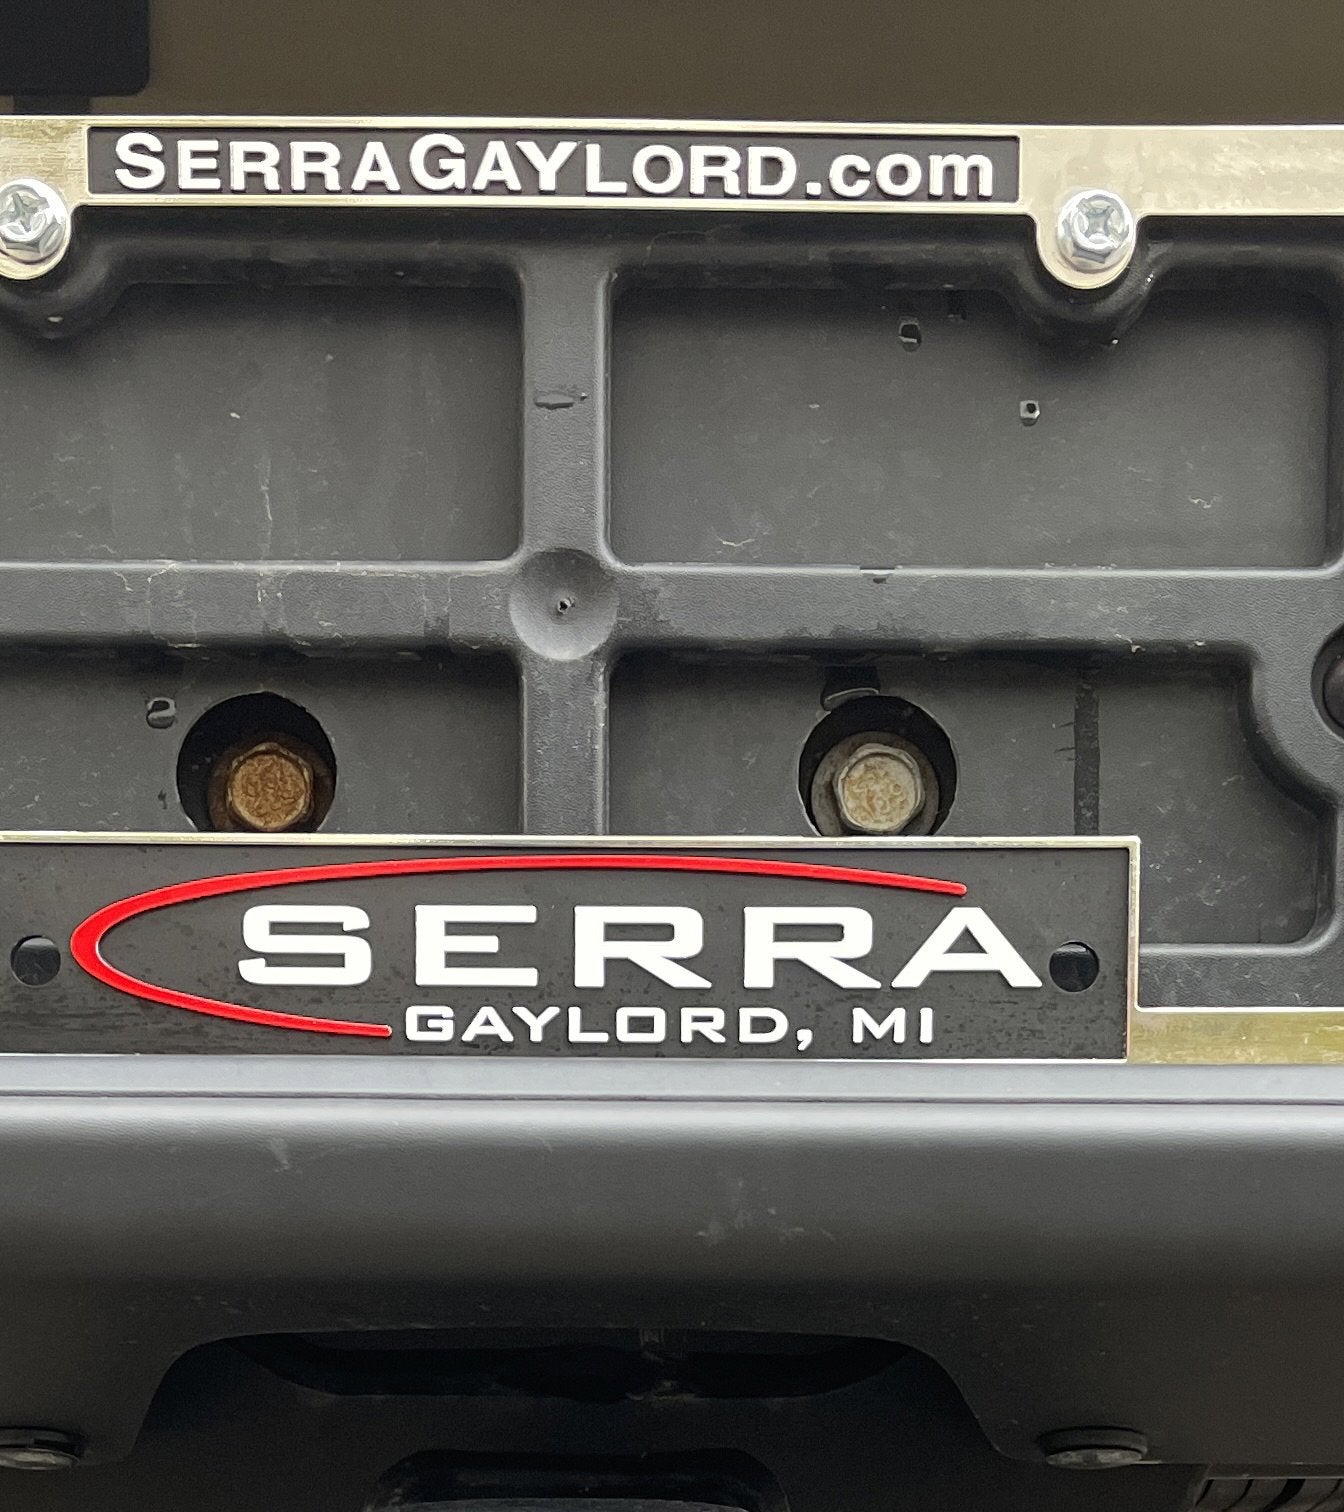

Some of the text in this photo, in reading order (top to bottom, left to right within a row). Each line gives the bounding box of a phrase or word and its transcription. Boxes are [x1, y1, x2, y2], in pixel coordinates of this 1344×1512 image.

[114, 132, 994, 198] SERRAGAYLORD.com
[238, 903, 1042, 991] SERRA
[405, 1005, 935, 1052] GAYLORD, MI
